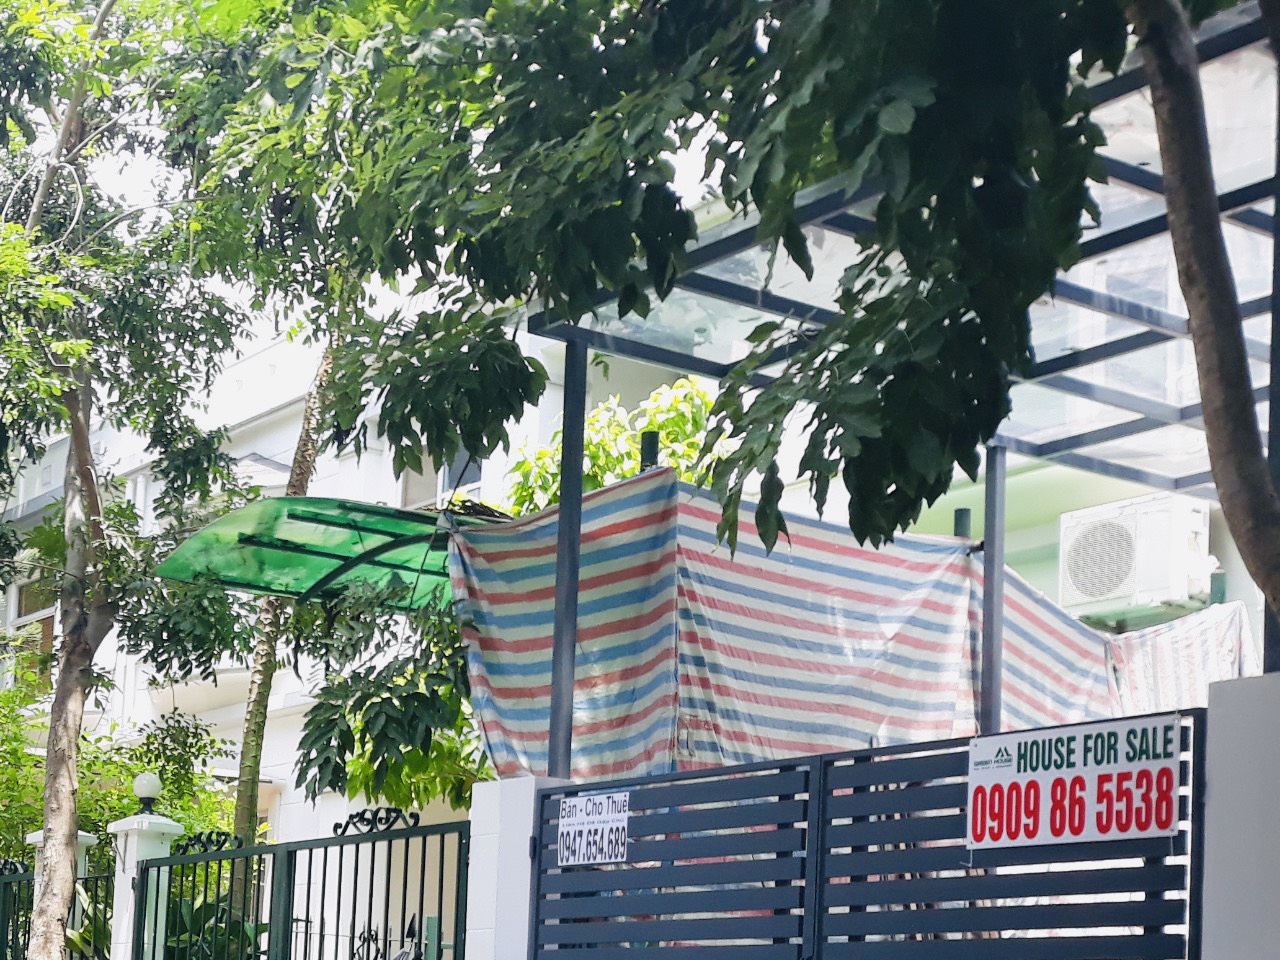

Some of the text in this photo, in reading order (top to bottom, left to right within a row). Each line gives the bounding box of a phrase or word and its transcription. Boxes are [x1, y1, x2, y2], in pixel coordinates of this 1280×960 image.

[1017, 725, 1175, 774] HOUSE FOR SALE
[560, 800, 577, 819] Bán
[585, 798, 603, 817] Cho
[606, 794, 627, 815] Thuê
[972, 767, 1175, 843] 0909 86 5538
[559, 826, 627, 863] 0947.654.689
